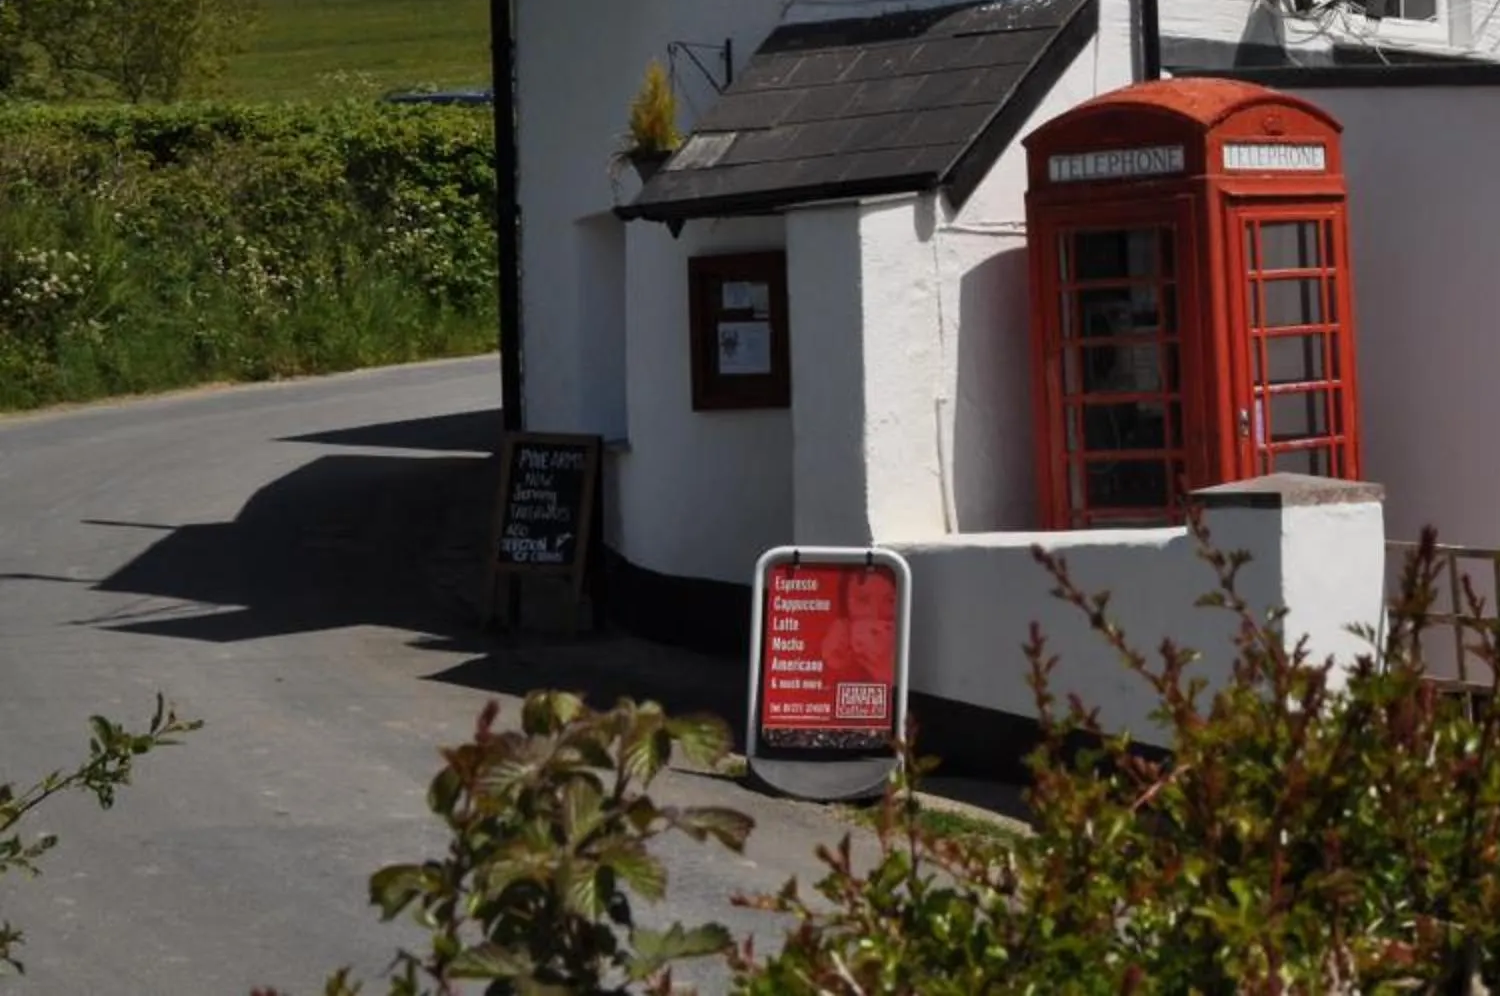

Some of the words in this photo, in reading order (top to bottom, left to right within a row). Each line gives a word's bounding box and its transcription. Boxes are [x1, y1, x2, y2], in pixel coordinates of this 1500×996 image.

[1053, 146, 1183, 179] TELEPHONE
[1227, 144, 1323, 168] TELEPHONE
[775, 576, 819, 593] Espresso
[773, 596, 831, 613] Cappuccino
[773, 616, 800, 632] Latte
[772, 636, 805, 652] Mocha
[771, 656, 824, 673] Americano
